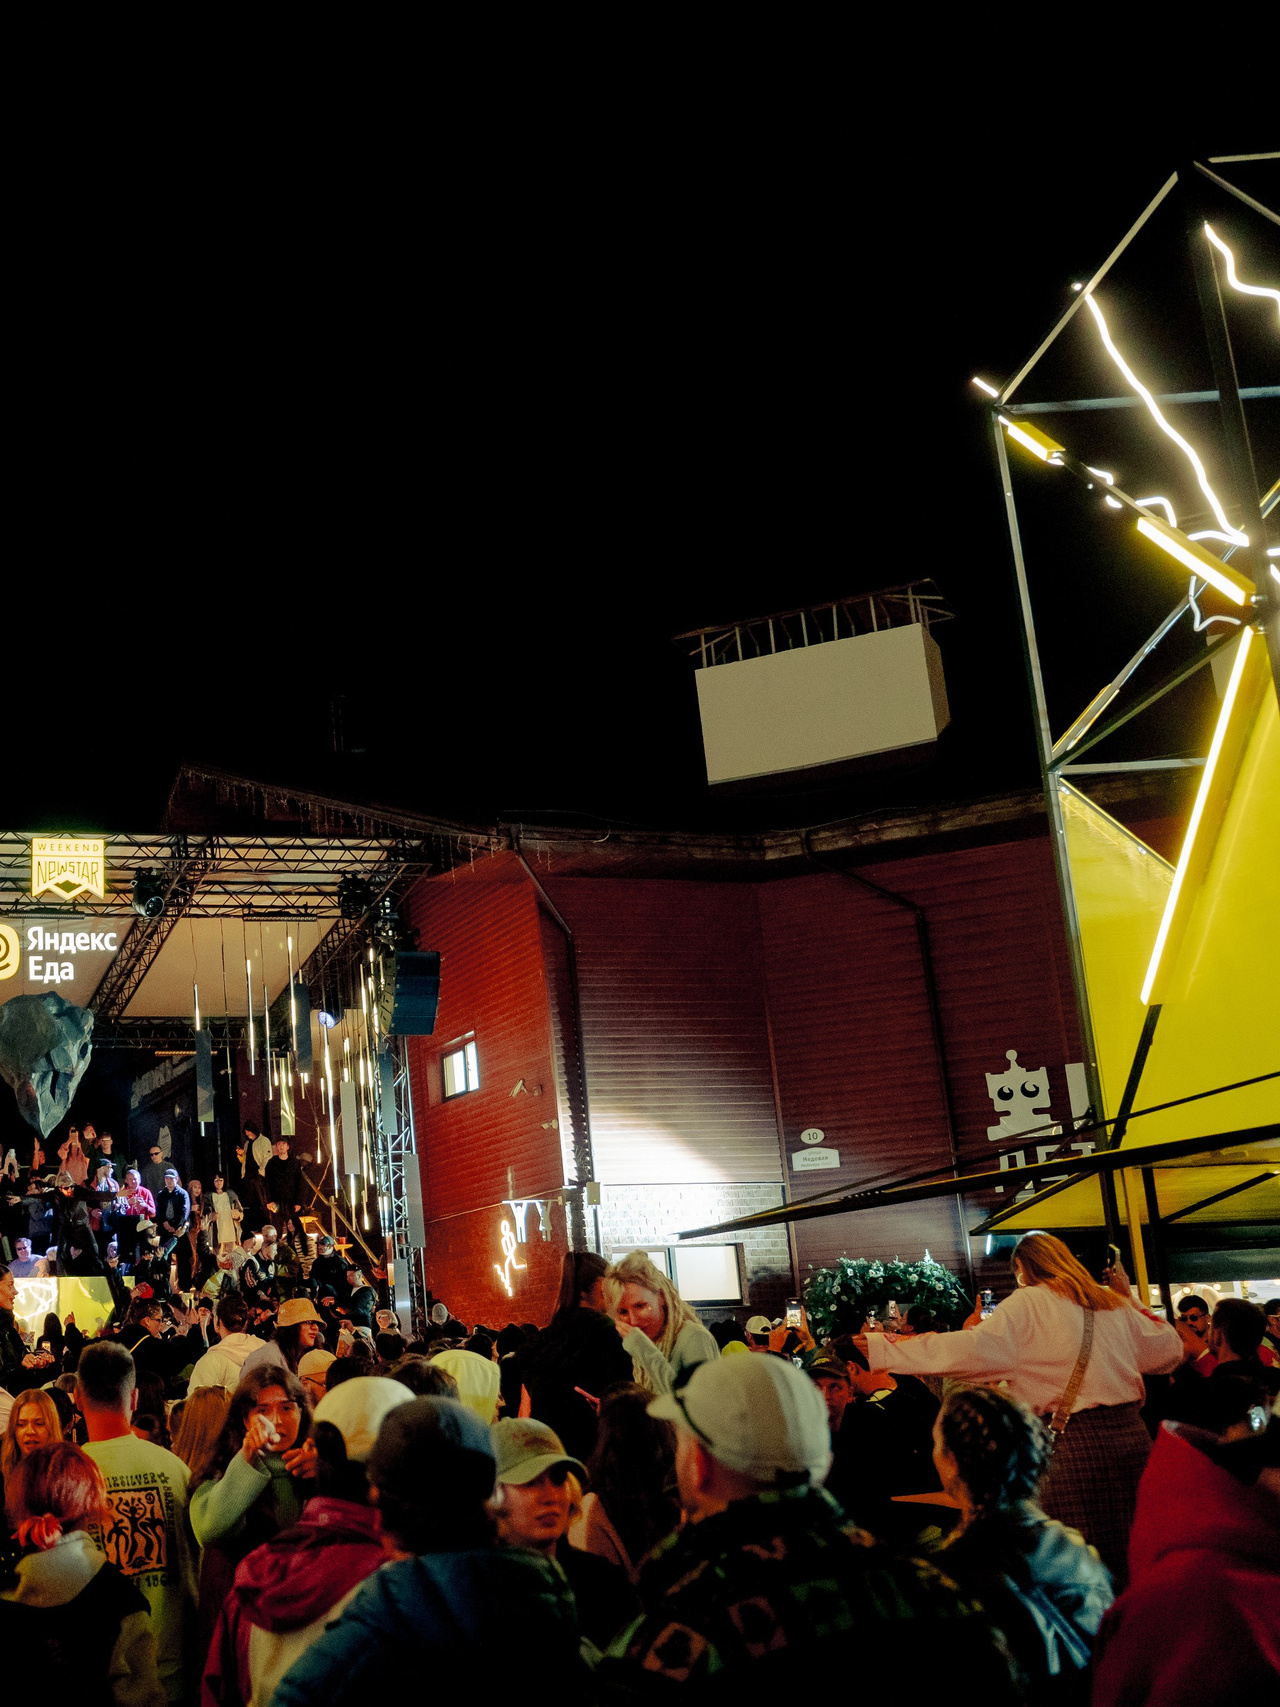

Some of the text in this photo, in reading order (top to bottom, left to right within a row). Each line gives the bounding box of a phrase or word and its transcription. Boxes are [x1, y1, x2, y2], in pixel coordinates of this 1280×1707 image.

[37, 842, 100, 853] WEEKEND
[26, 926, 117, 954] Яндекс
[28, 955, 75, 984] Еда
[807, 1131, 818, 1141] 10
